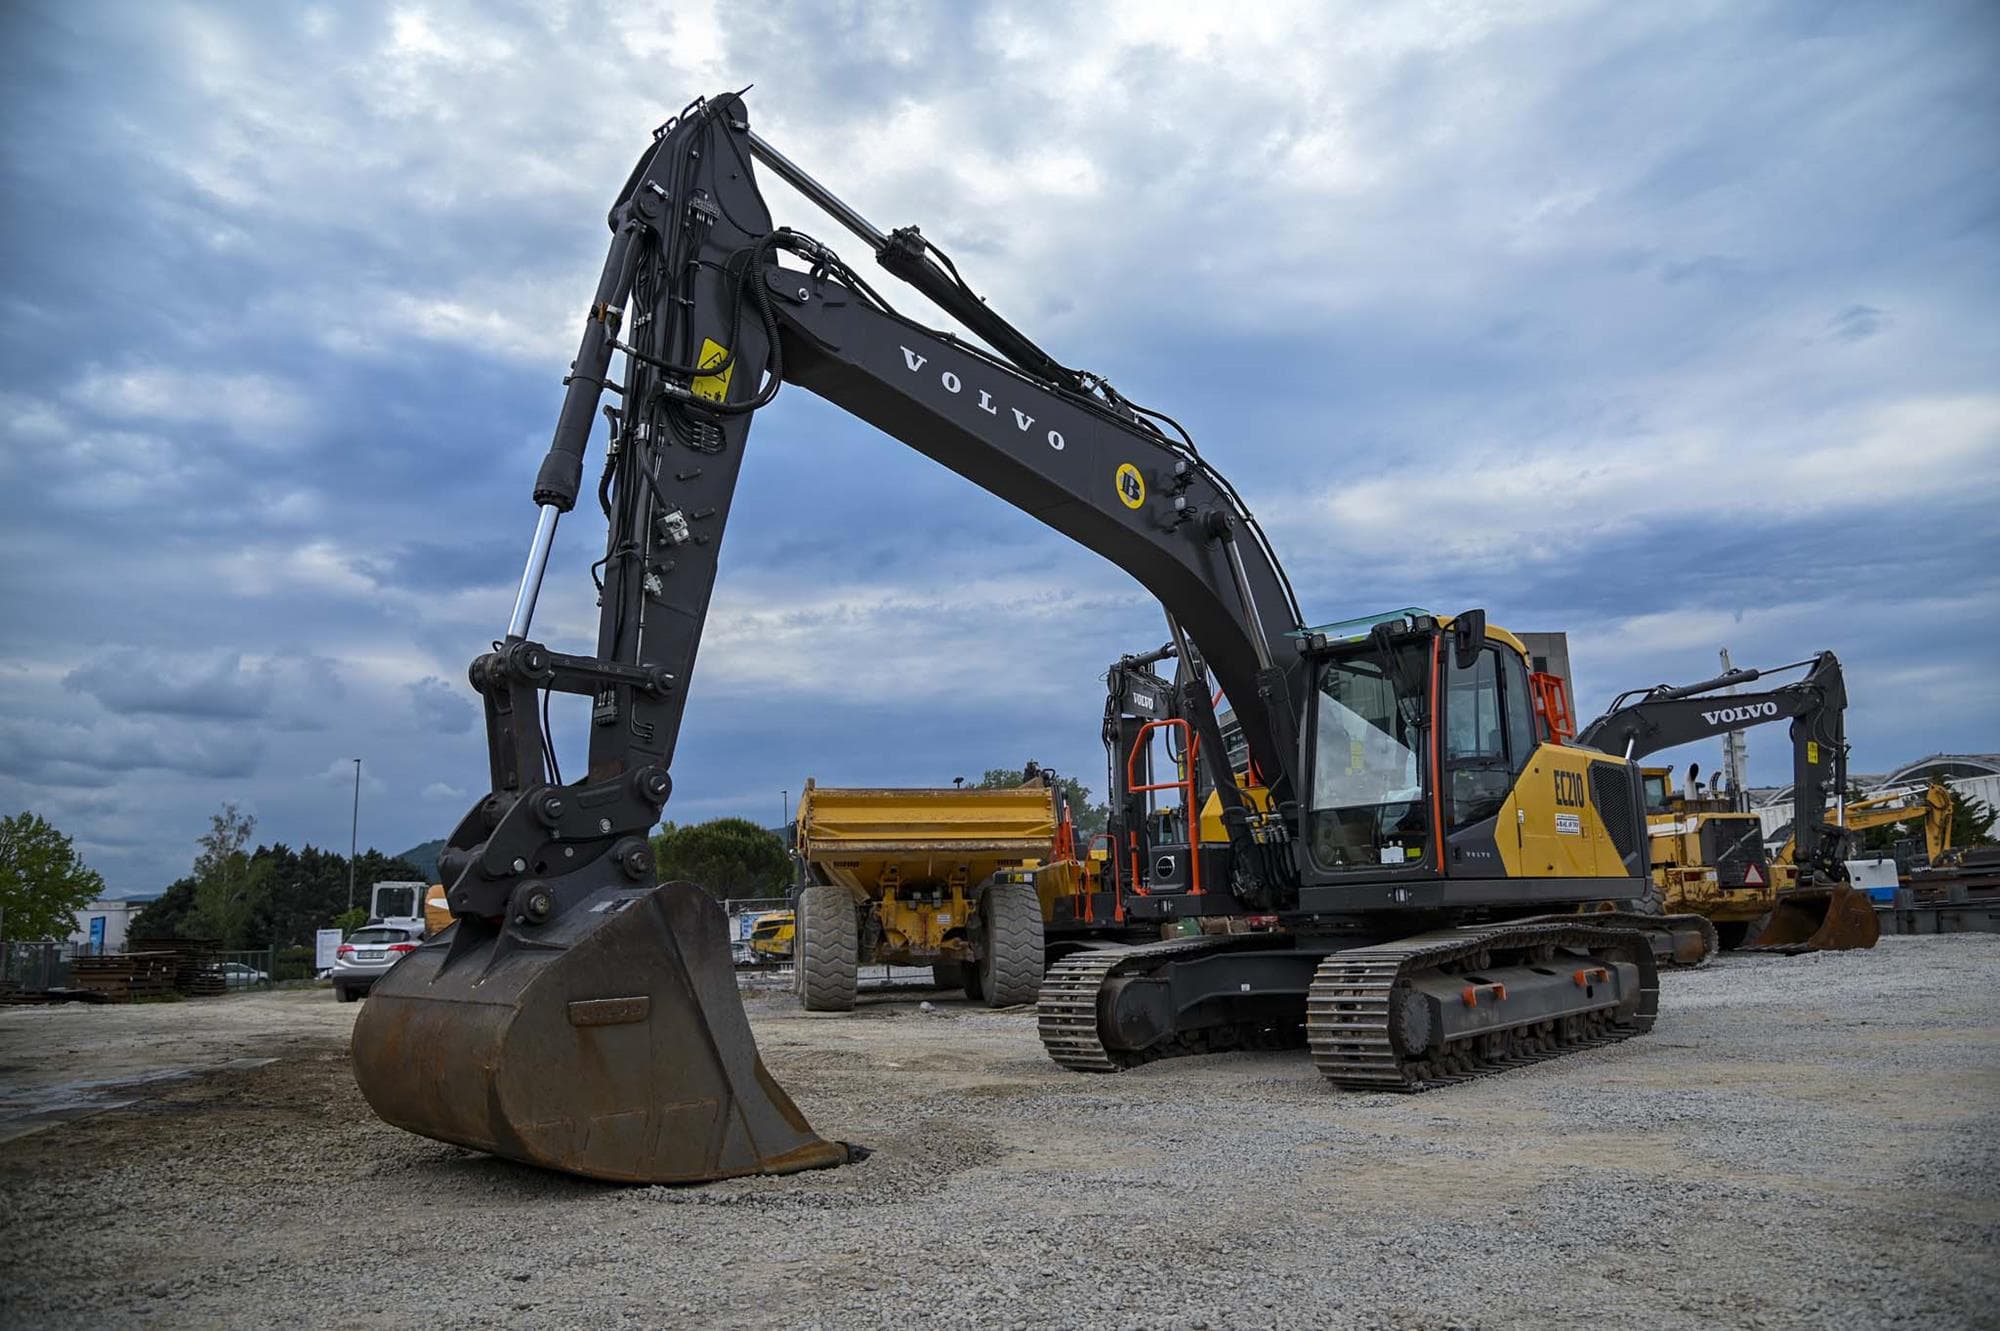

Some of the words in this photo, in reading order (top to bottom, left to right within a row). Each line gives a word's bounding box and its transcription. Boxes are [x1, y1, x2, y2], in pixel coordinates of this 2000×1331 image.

[900, 346, 1065, 450] VOLVO
[1133, 692, 1154, 710] VOLVO
[1701, 702, 1778, 725] VOLVO
[1553, 769, 1585, 808] EC210
